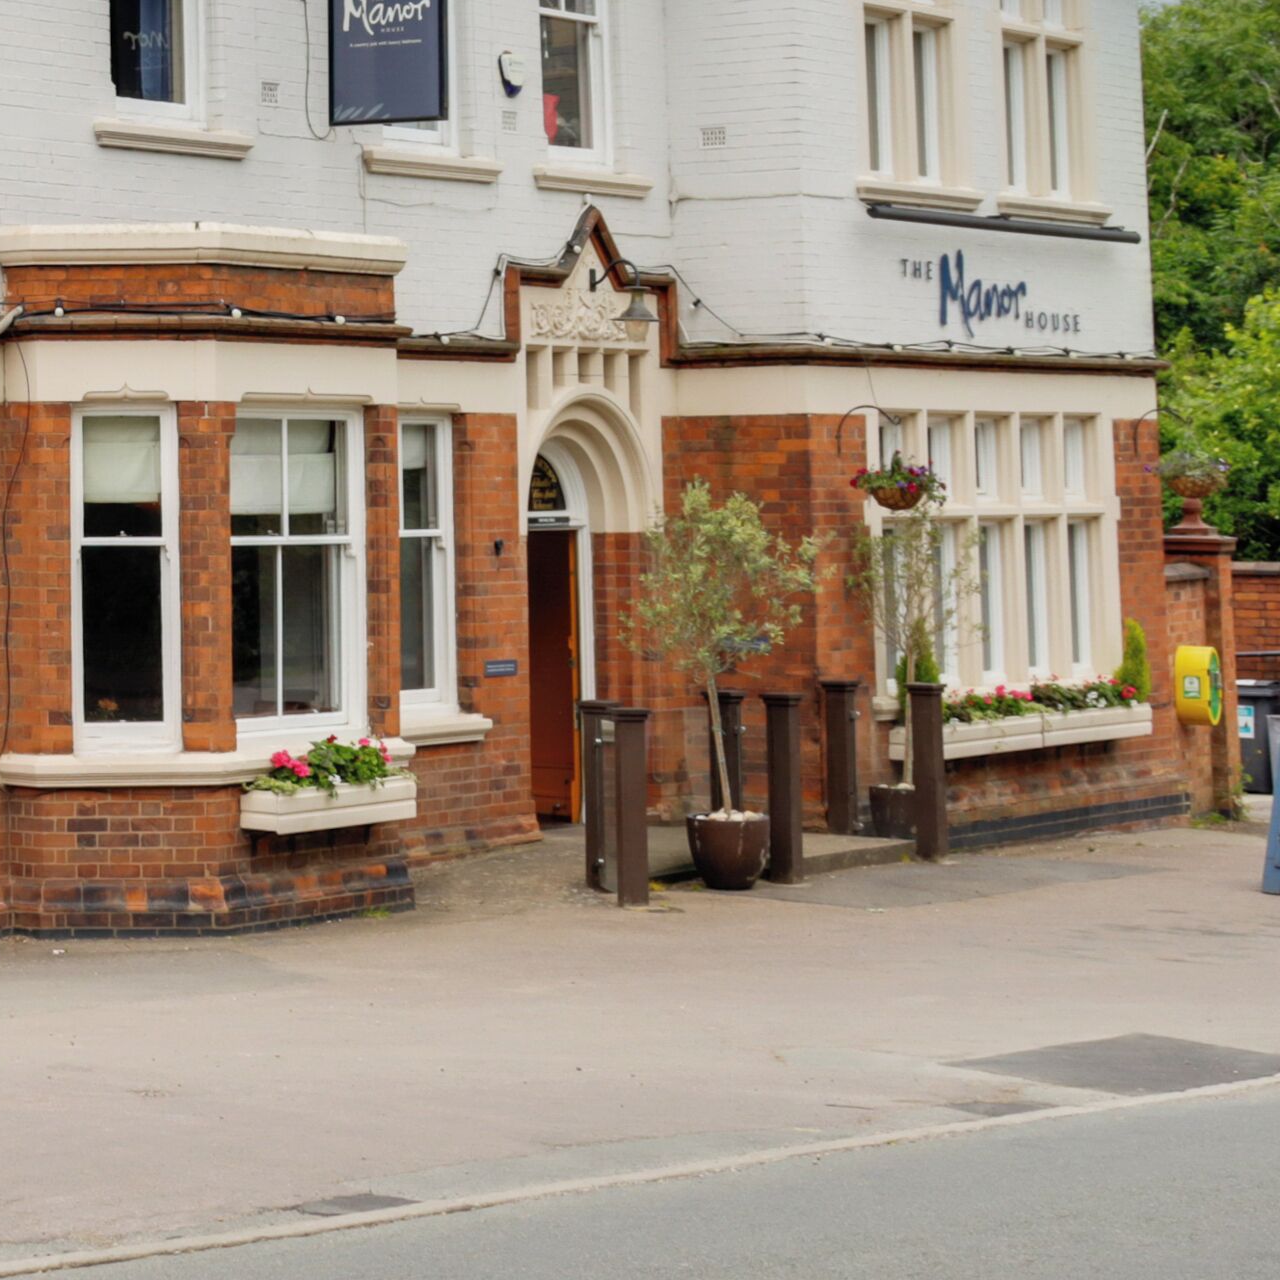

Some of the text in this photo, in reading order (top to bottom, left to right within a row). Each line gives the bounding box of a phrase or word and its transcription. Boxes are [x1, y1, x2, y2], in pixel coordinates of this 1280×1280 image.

[900, 258, 933, 280] THE
[939, 249, 1027, 339] Manor
[1025, 311, 1081, 333] HOUSE
